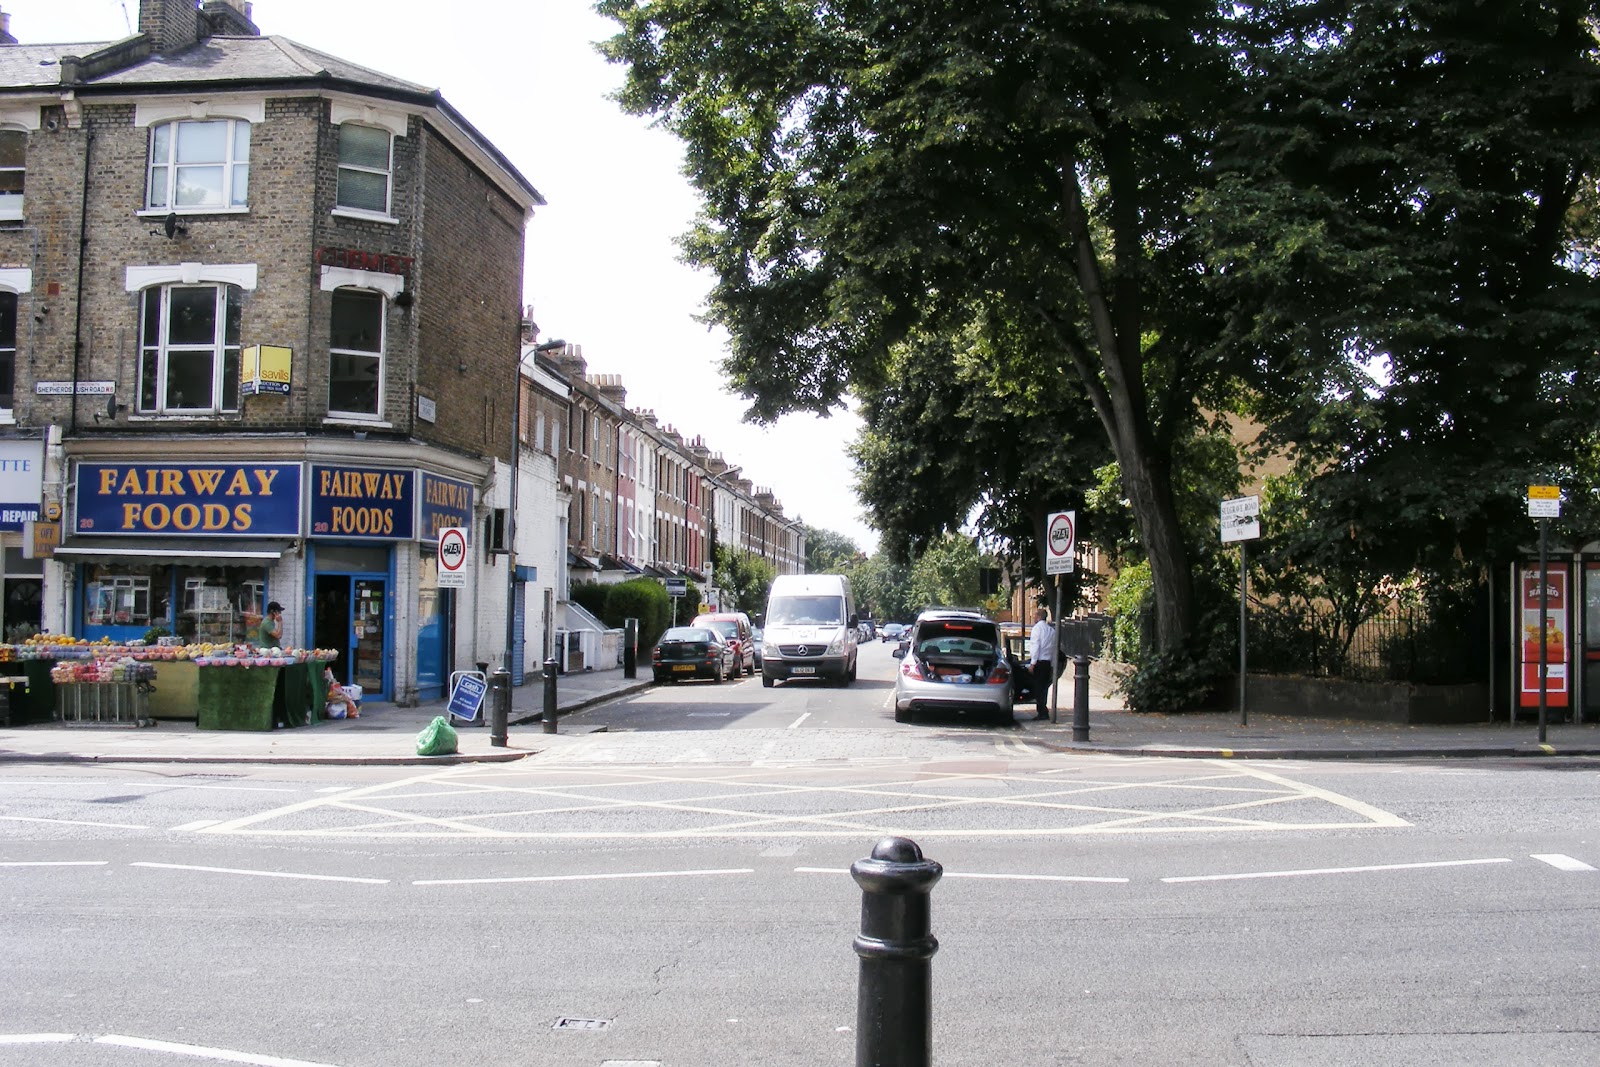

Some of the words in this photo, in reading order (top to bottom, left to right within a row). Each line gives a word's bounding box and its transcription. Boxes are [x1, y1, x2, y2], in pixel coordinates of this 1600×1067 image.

[262, 370, 289, 381] savills
[38, 386, 72, 395] SHEPHERDS
[76, 386, 88, 395] USH
[89, 386, 105, 395] ROAD
[98, 468, 279, 496] FAIRWAY
[320, 470, 405, 500] FAIRWAY
[426, 478, 469, 511] FAIRWAY
[3, 510, 38, 522] REPAIR
[80, 518, 94, 528] 20
[121, 503, 252, 531] FOODS
[332, 506, 393, 535] FOODS
[314, 522, 328, 532] 20
